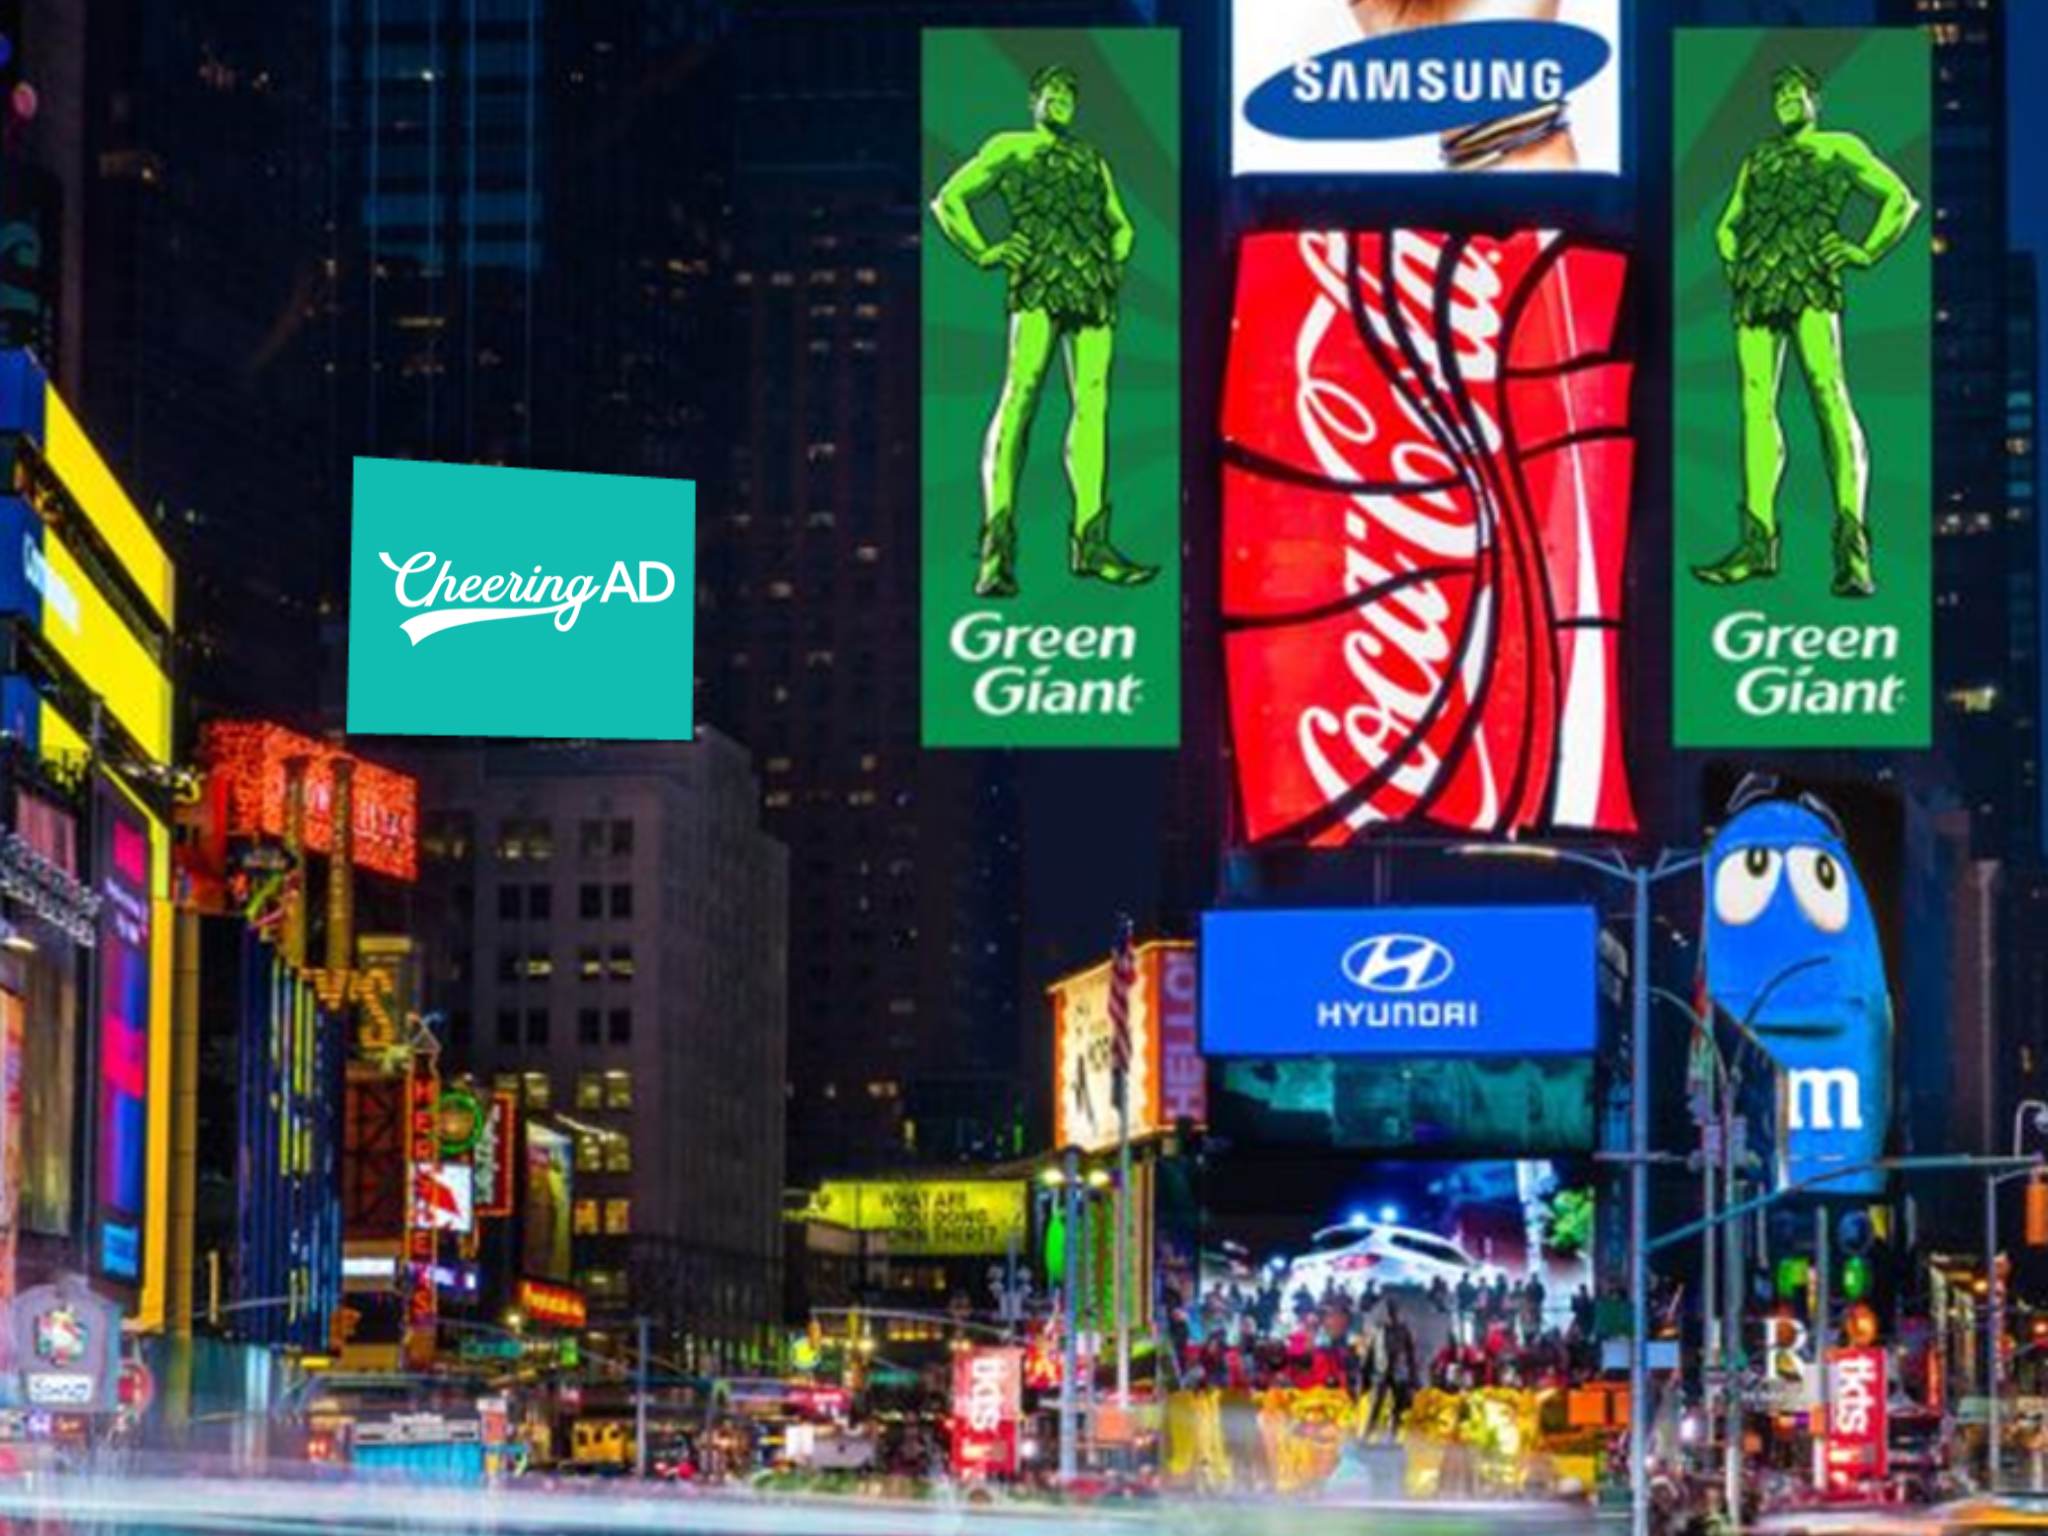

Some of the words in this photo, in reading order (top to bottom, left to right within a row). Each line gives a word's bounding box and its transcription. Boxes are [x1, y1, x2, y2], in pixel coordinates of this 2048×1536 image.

[1293, 58, 1563, 102] SAMSUNG
[949, 611, 1136, 662] Green
[1711, 610, 1899, 662] Green
[972, 664, 1143, 716] Giant
[1735, 664, 1906, 716] Giant
[1317, 1002, 1478, 1027] HYUNDAI
[1789, 1068, 1863, 1130] m
[1837, 1355, 1877, 1435] tkts
